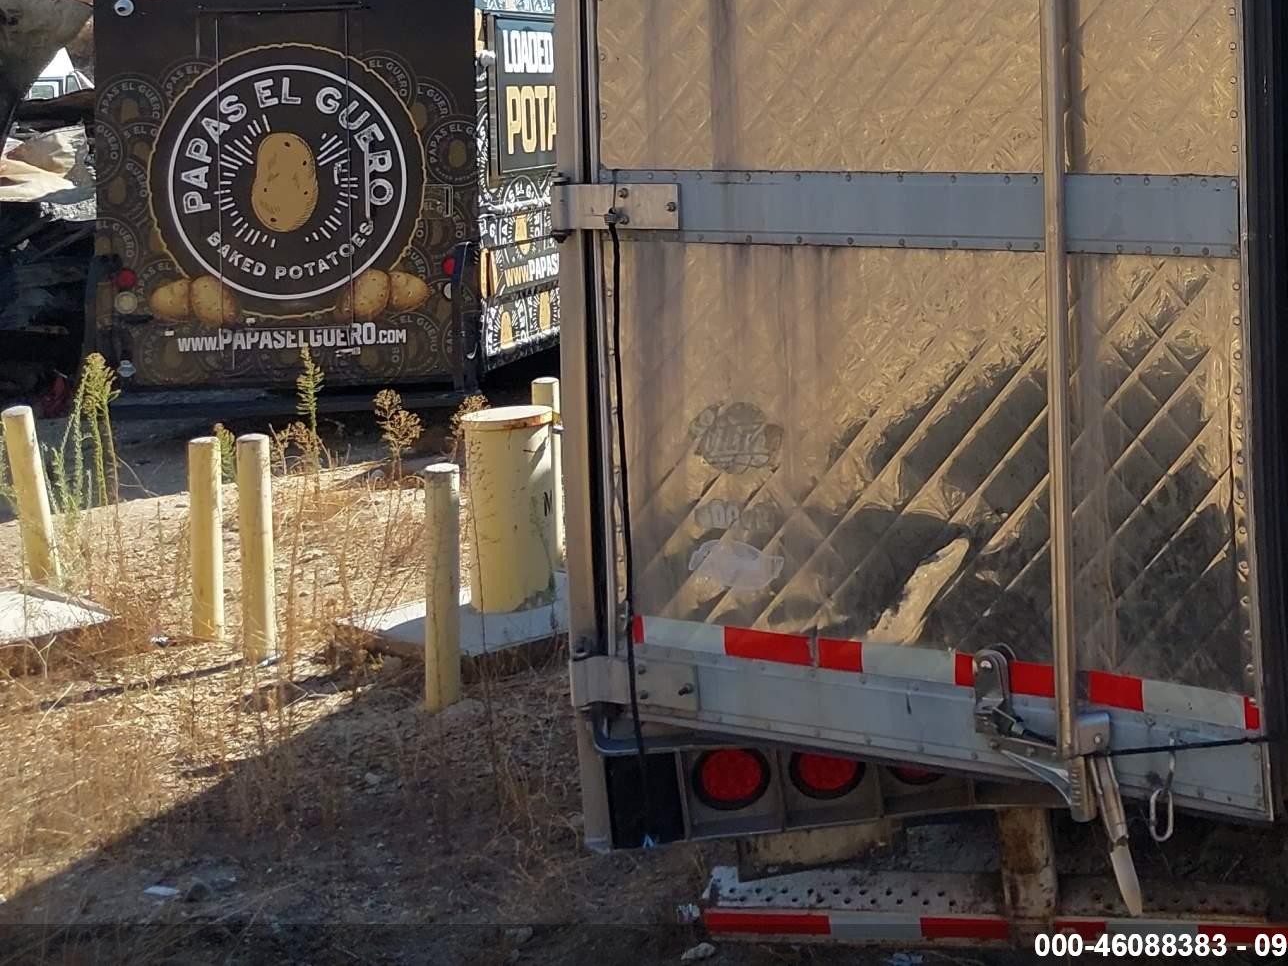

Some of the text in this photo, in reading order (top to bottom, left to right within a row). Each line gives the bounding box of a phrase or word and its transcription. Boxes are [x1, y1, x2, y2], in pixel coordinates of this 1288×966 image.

[503, 30, 554, 73] LOADED
[369, 60, 408, 97] EL GUERO
[121, 82, 135, 91] EL
[138, 85, 161, 119] GUERO
[427, 88, 449, 118] GUER
[181, 77, 394, 214] PAPAS EL GUERO
[429, 124, 462, 163] PAPAS EL
[207, 216, 375, 280] BAKED POTATOES
